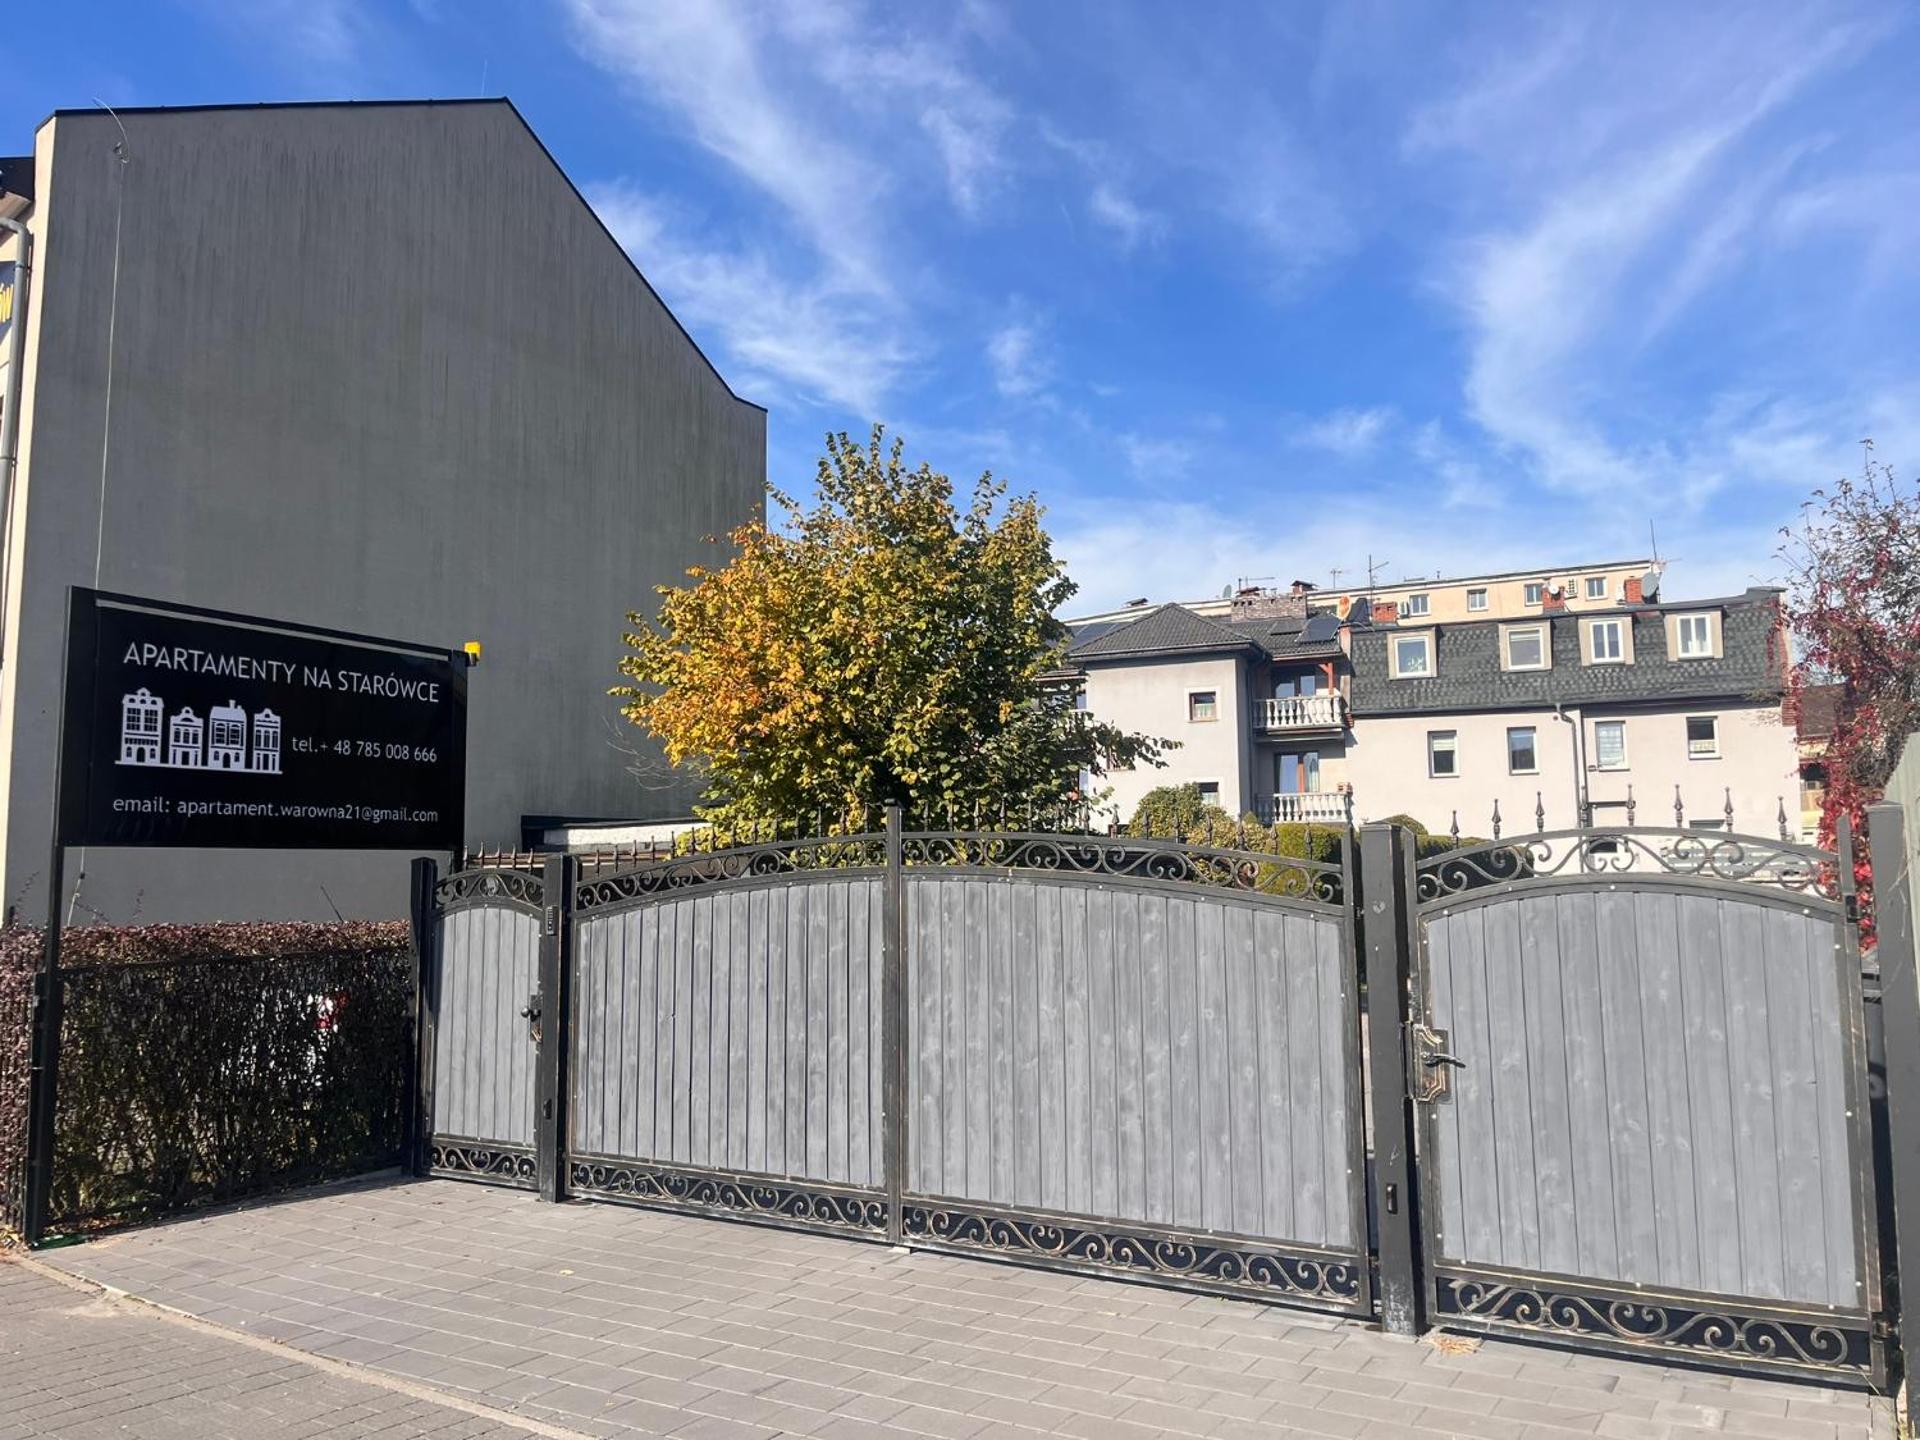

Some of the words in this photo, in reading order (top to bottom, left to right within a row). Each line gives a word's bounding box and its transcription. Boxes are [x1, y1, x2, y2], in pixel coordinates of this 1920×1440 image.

[123, 641, 296, 684] APARTAMENTY
[304, 665, 332, 689] NA
[338, 670, 440, 703] STARÓWCE
[333, 739, 351, 756] 48
[356, 741, 381, 758] 785
[385, 744, 410, 760] 008
[414, 747, 438, 763] 666
[112, 796, 170, 813] email:
[177, 800, 439, 823] apartament.warowna21@gmail.com
